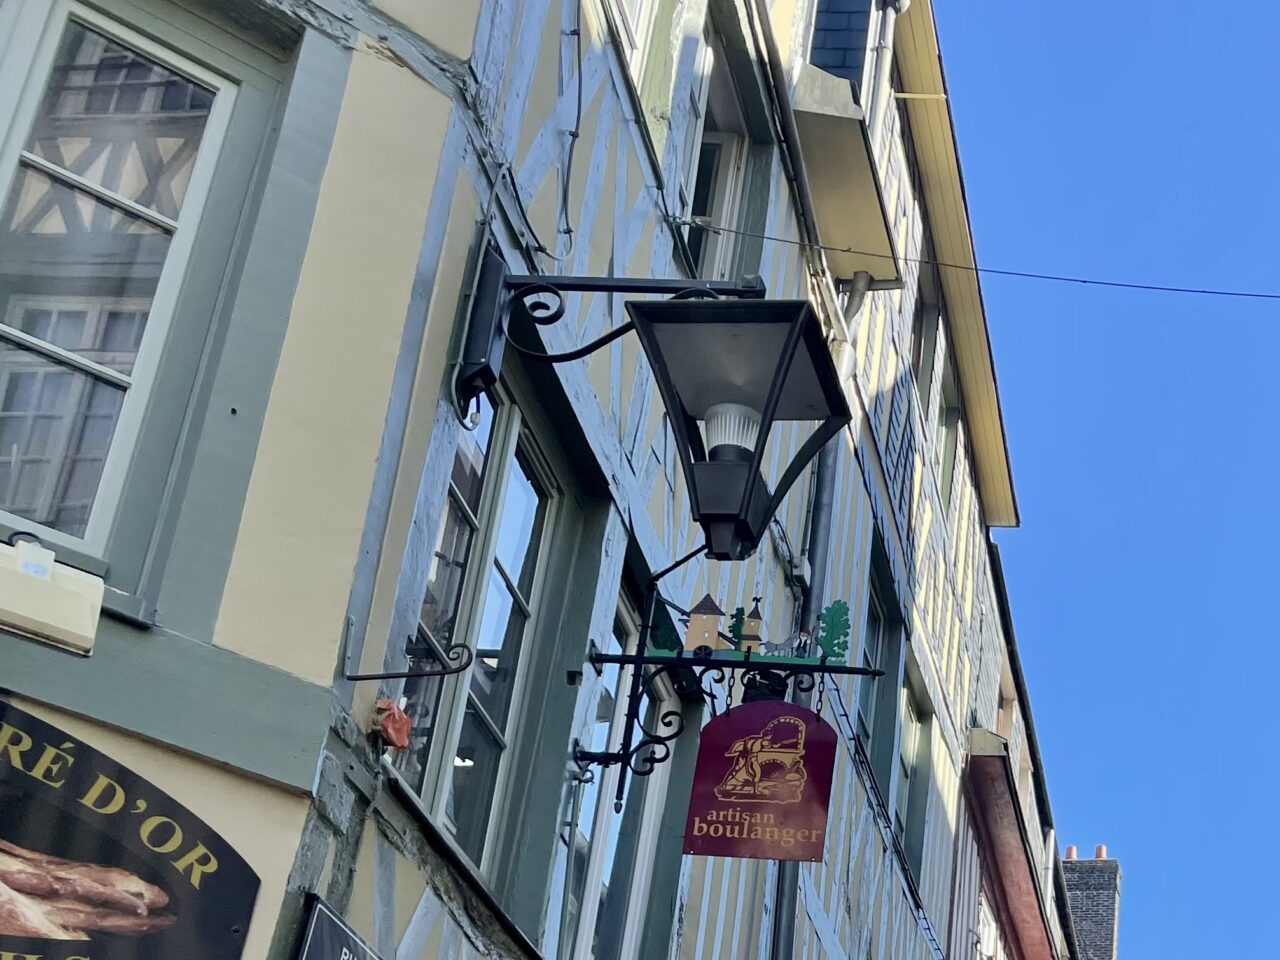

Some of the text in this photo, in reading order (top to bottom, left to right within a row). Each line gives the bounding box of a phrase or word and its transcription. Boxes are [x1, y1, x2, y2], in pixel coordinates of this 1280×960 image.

[77, 771, 219, 890] D'OR
[707, 807, 775, 825] artisan
[693, 817, 821, 847] boulanger
